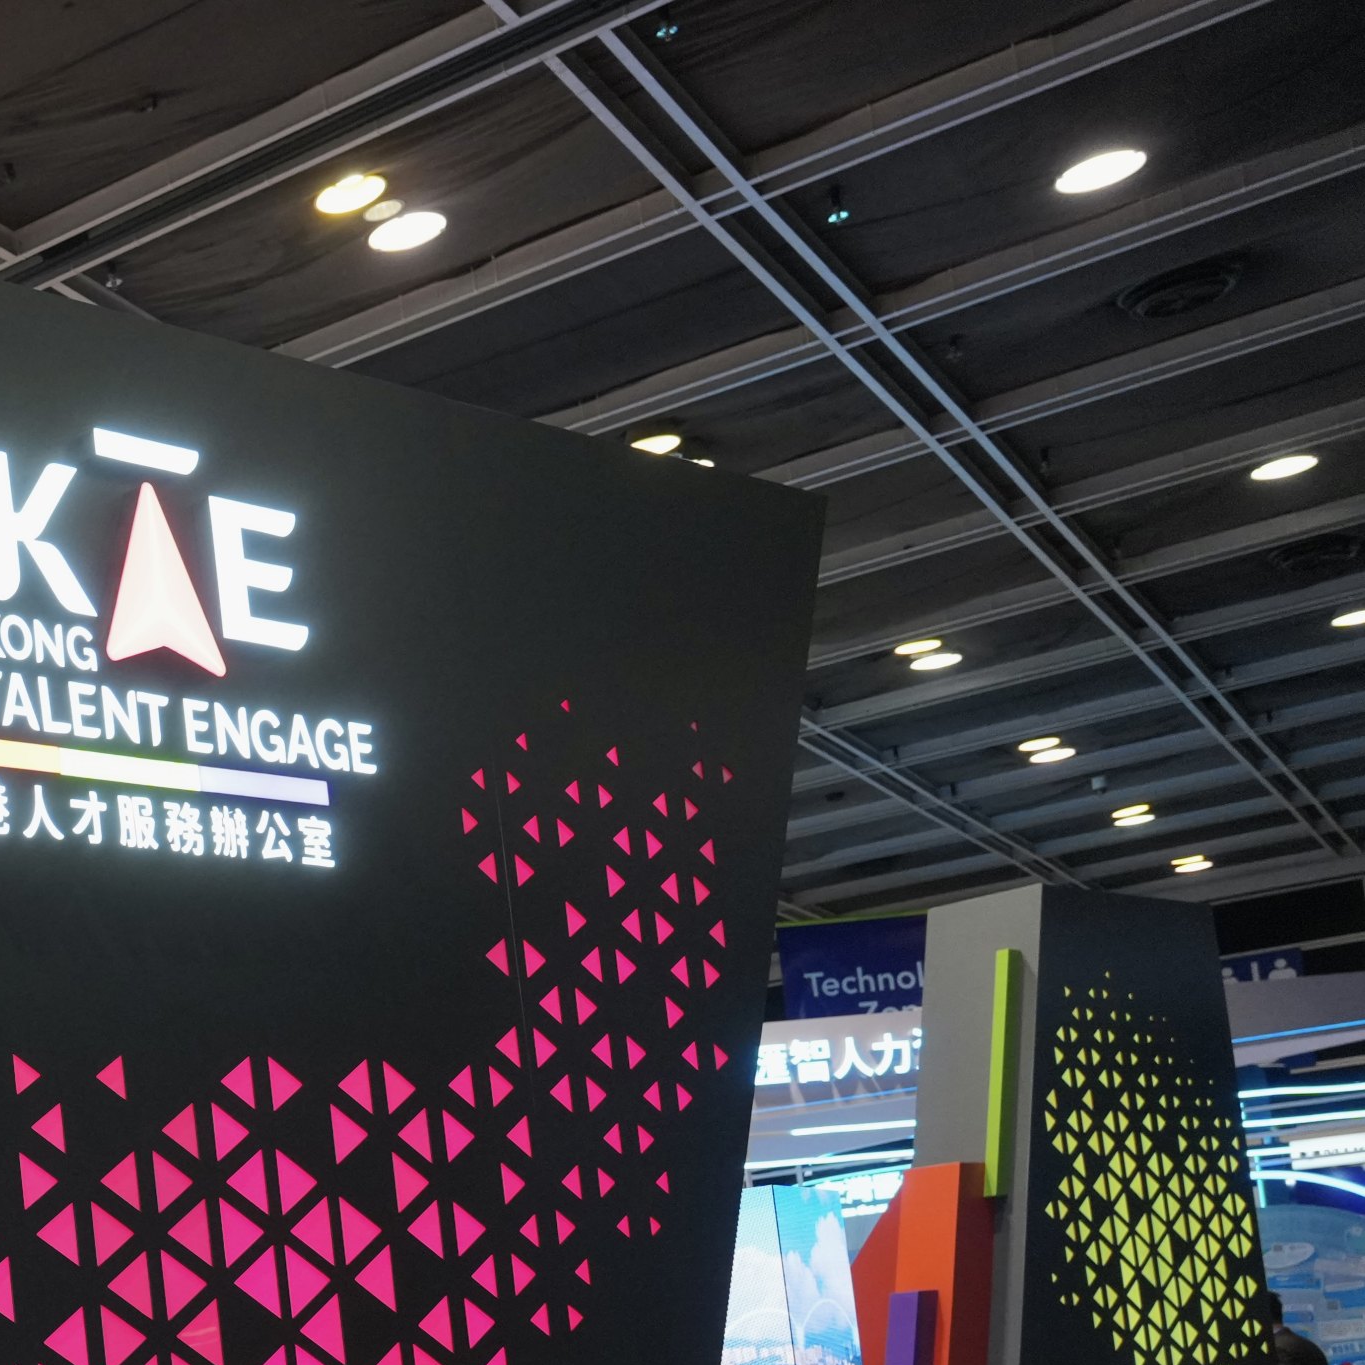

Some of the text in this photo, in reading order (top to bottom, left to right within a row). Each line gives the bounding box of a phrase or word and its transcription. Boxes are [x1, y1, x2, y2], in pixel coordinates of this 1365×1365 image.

[182, 698, 377, 774] ENGAGE
[755, 1028, 922, 1086] 匯智人力
